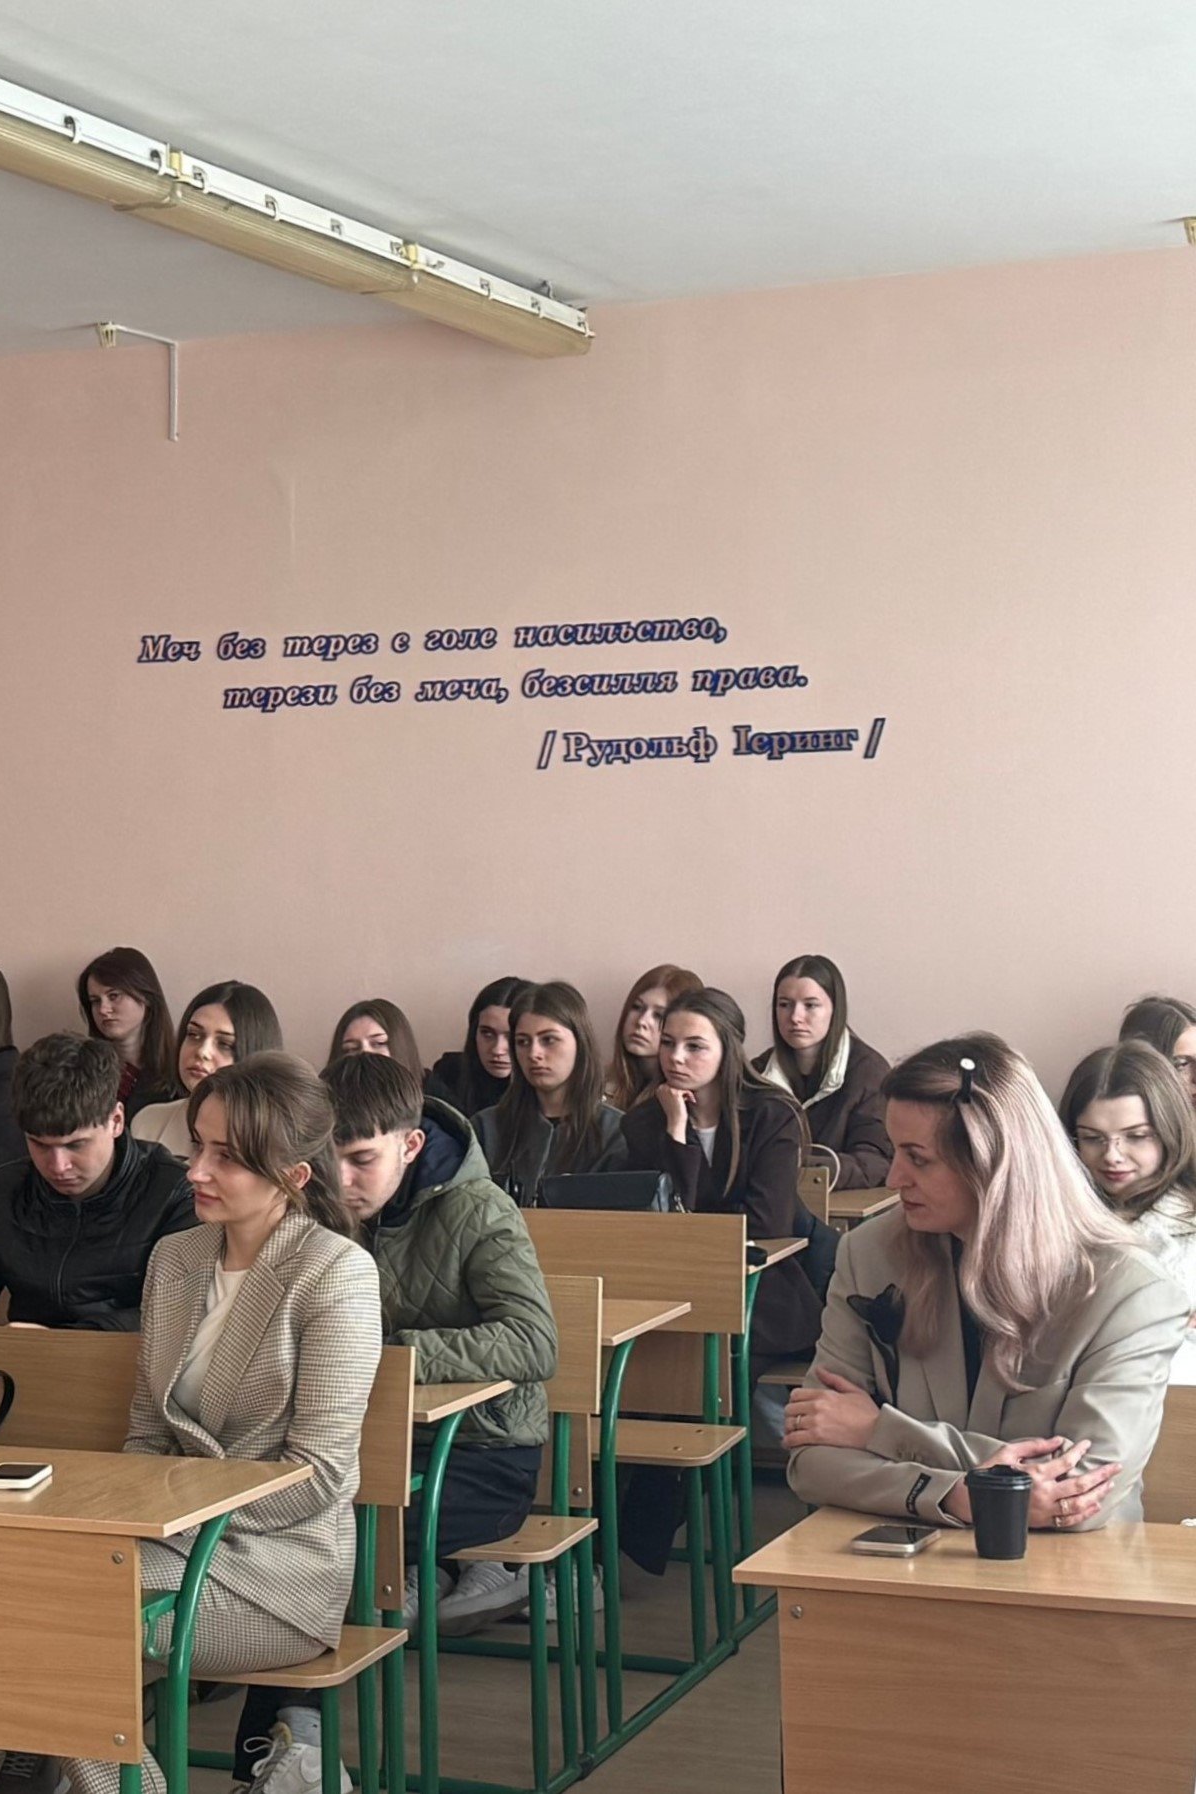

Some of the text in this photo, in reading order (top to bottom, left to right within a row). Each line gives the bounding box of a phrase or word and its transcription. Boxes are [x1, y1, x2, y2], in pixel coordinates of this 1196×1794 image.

[136, 616, 728, 664] Меч без терез є голе насильство,
[222, 665, 809, 714] терези без меча, безсилля права.
